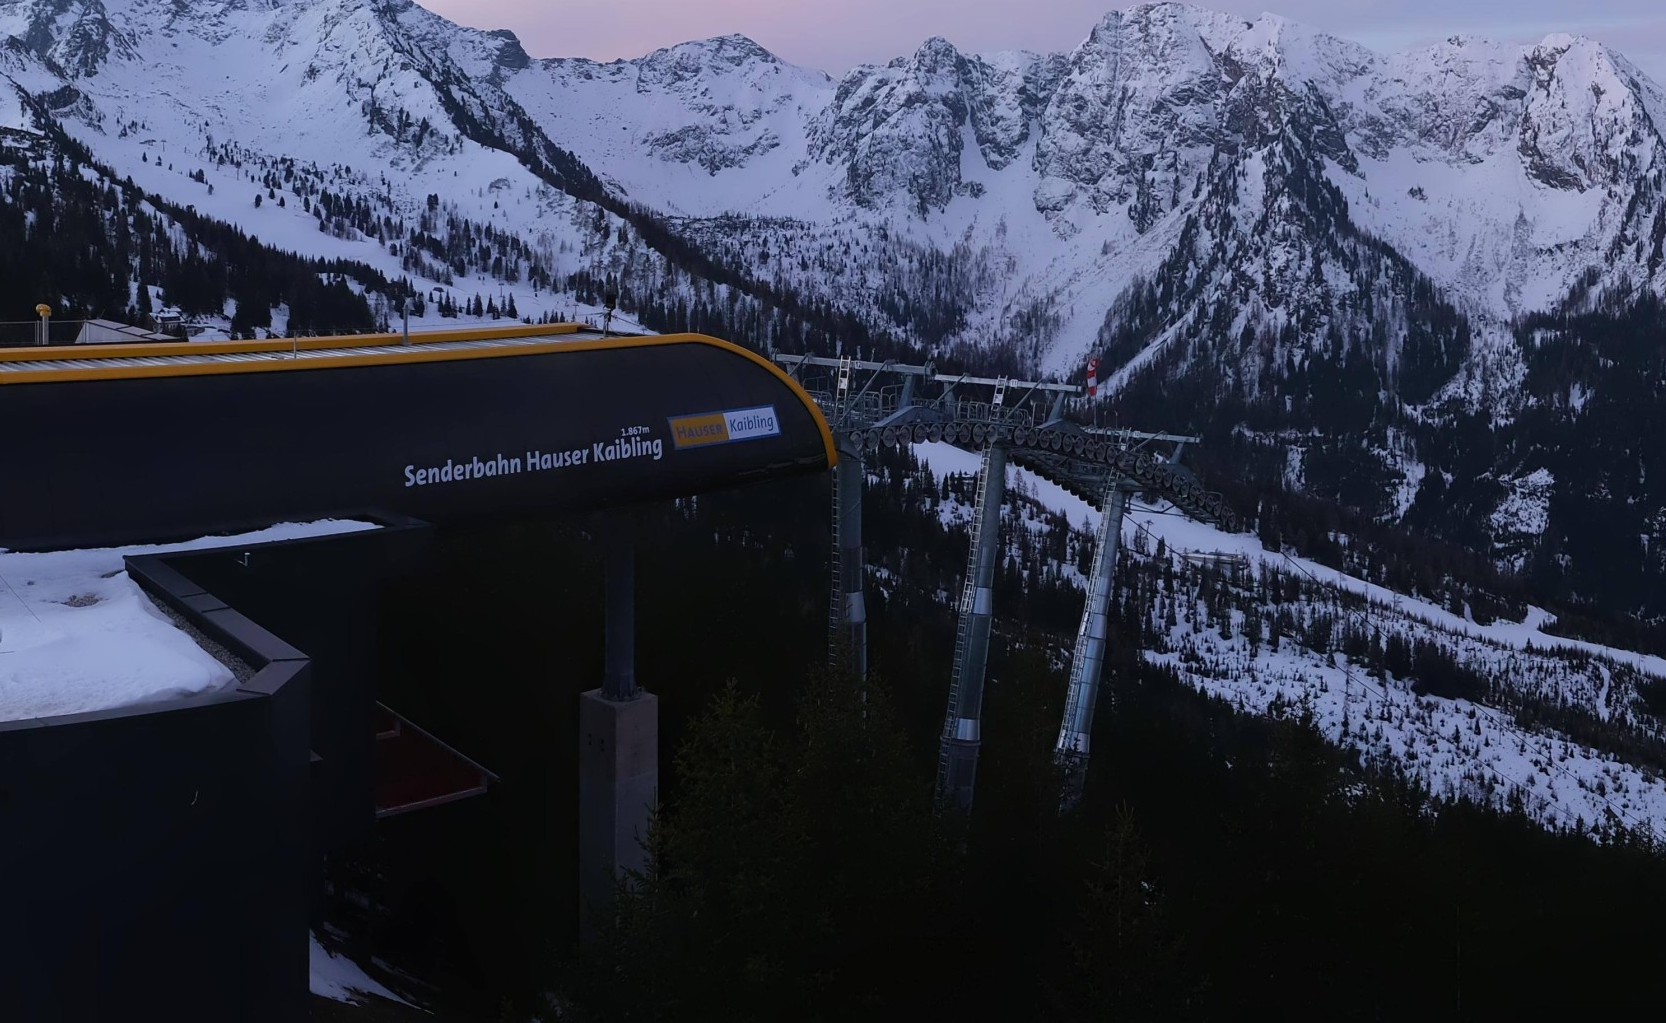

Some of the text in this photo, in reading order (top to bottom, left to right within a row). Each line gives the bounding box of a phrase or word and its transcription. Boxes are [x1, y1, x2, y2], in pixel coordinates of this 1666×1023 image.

[620, 425, 650, 437] 1.867m
[729, 414, 774, 432] Kaibling
[404, 436, 663, 488] Senderbahn Hauser Kaibling
